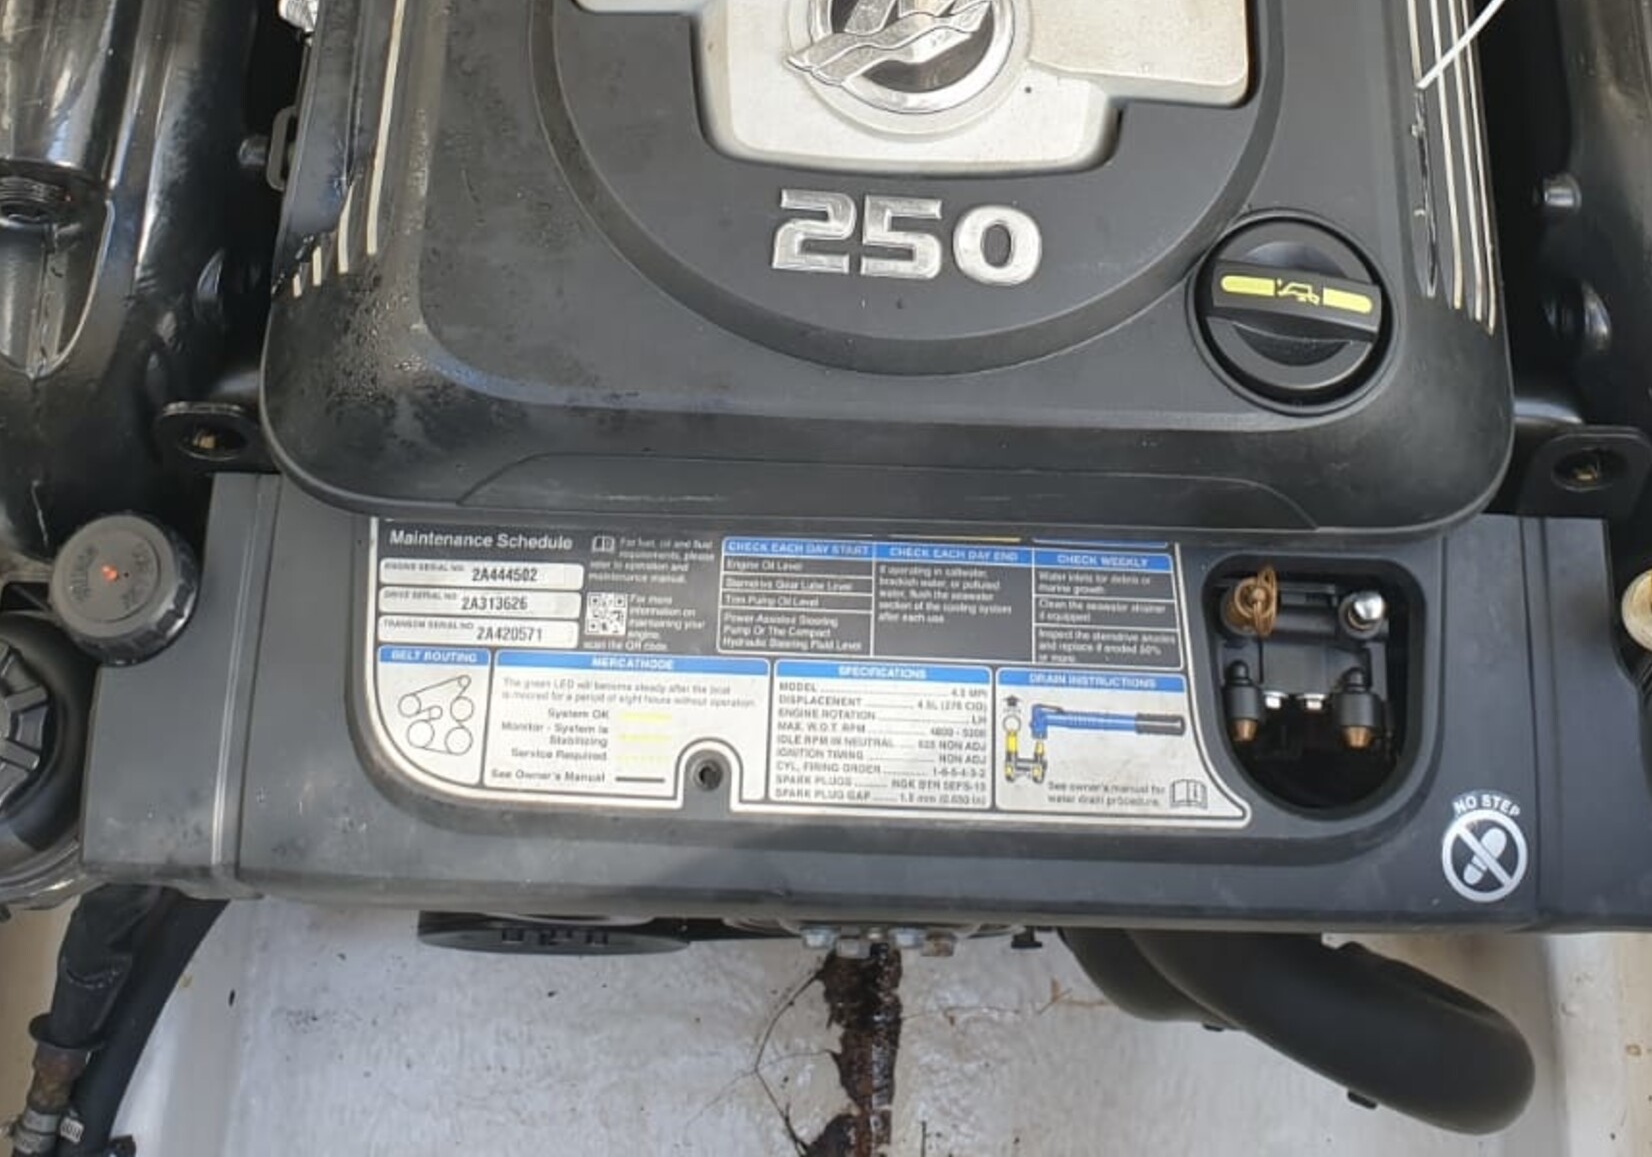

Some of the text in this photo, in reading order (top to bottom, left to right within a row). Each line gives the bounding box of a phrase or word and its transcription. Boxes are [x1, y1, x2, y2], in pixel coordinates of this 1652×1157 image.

[772, 188, 1042, 286] 250
[390, 530, 573, 550] Maintenance Schedule
[728, 541, 767, 552] CHECK
[771, 543, 803, 553] EACH
[806, 544, 829, 554] DAY
[890, 547, 928, 557] CHECK
[933, 548, 965, 559] EACH
[1057, 554, 1149, 566] CHECK WEEKLY
[392, 650, 478, 662] BELT ROUTING
[779, 682, 817, 691] MODEL
[1029, 673, 1157, 689] DRAIN INSTRUCTIONS
[779, 695, 862, 706] DISPLACEMENT
[778, 708, 875, 720] ENGINE ROTATION
[1453, 794, 1520, 816] NO STEP
